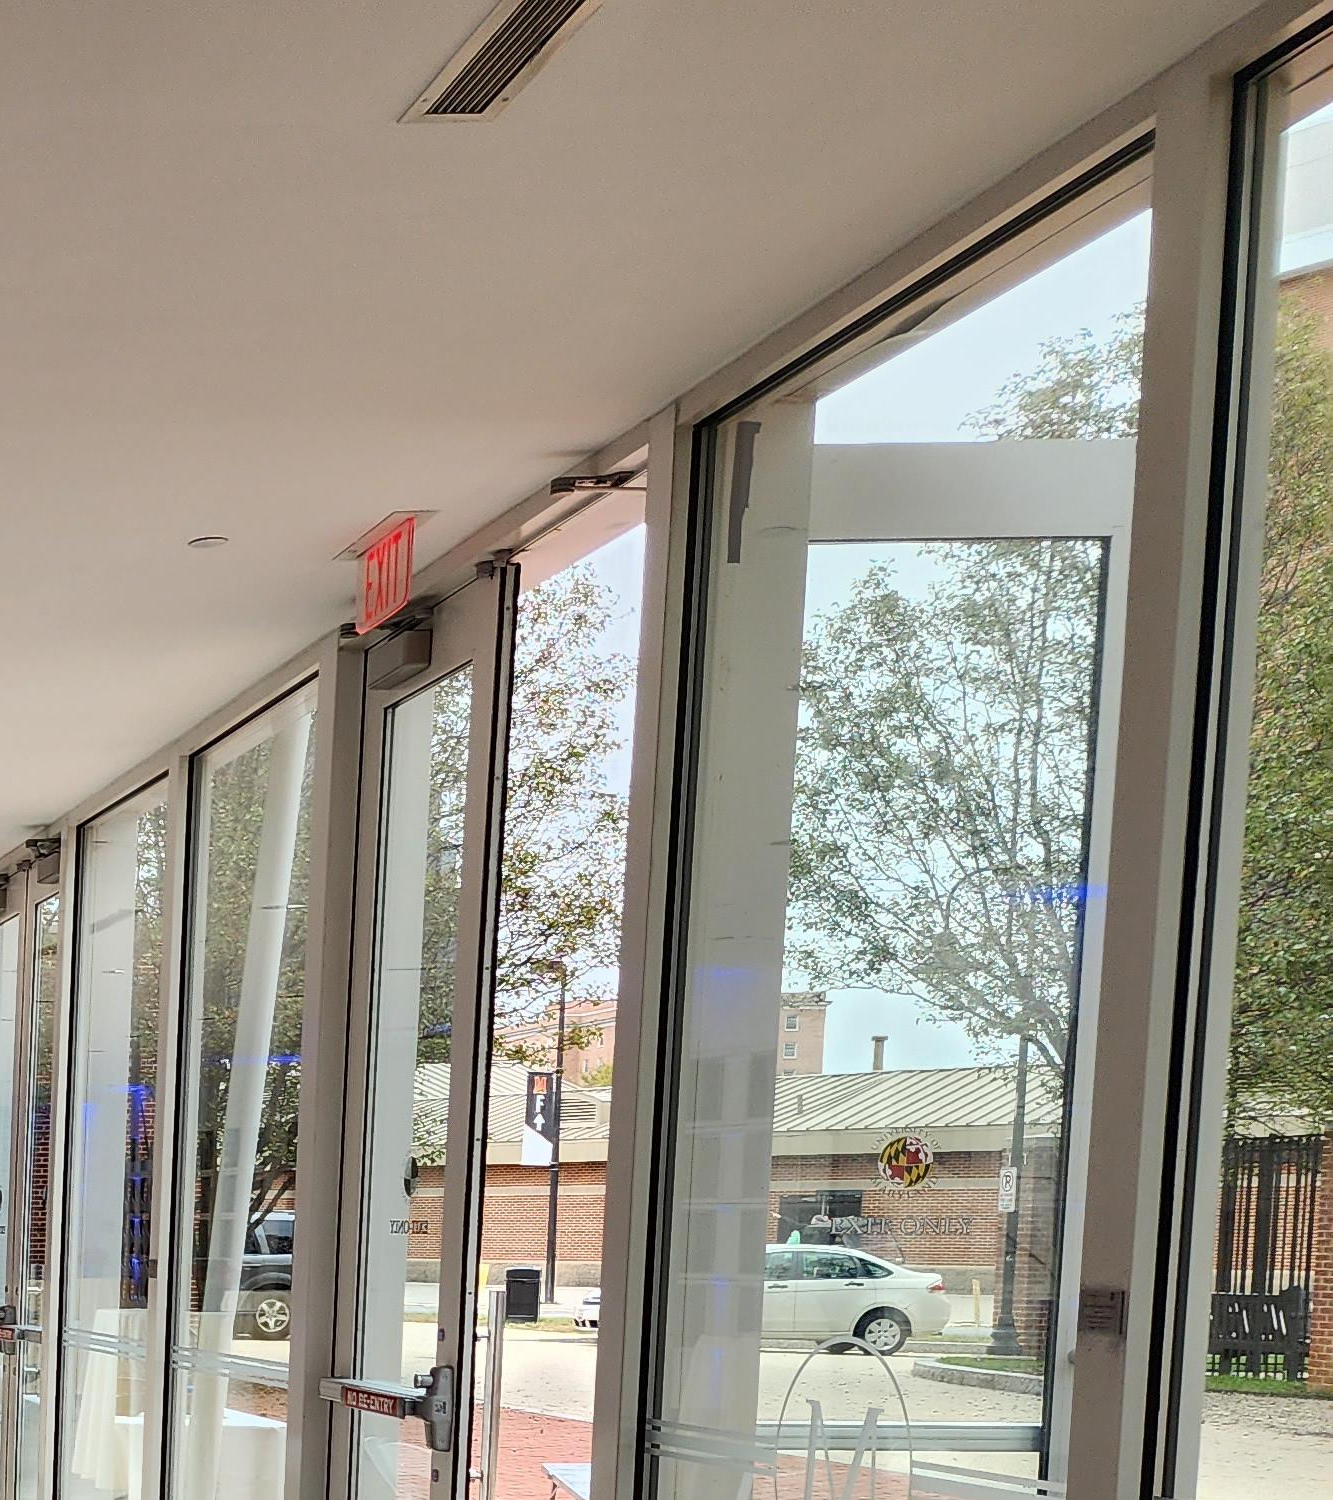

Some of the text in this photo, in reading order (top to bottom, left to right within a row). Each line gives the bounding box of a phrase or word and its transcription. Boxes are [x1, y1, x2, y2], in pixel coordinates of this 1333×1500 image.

[365, 529, 403, 622] EXIT
[870, 1127, 941, 1150] UNIVERSITY OF
[870, 1176, 939, 1198] MARYLAND
[831, 1216, 973, 1236] EXIT ONLY
[347, 1390, 357, 1406] NO
